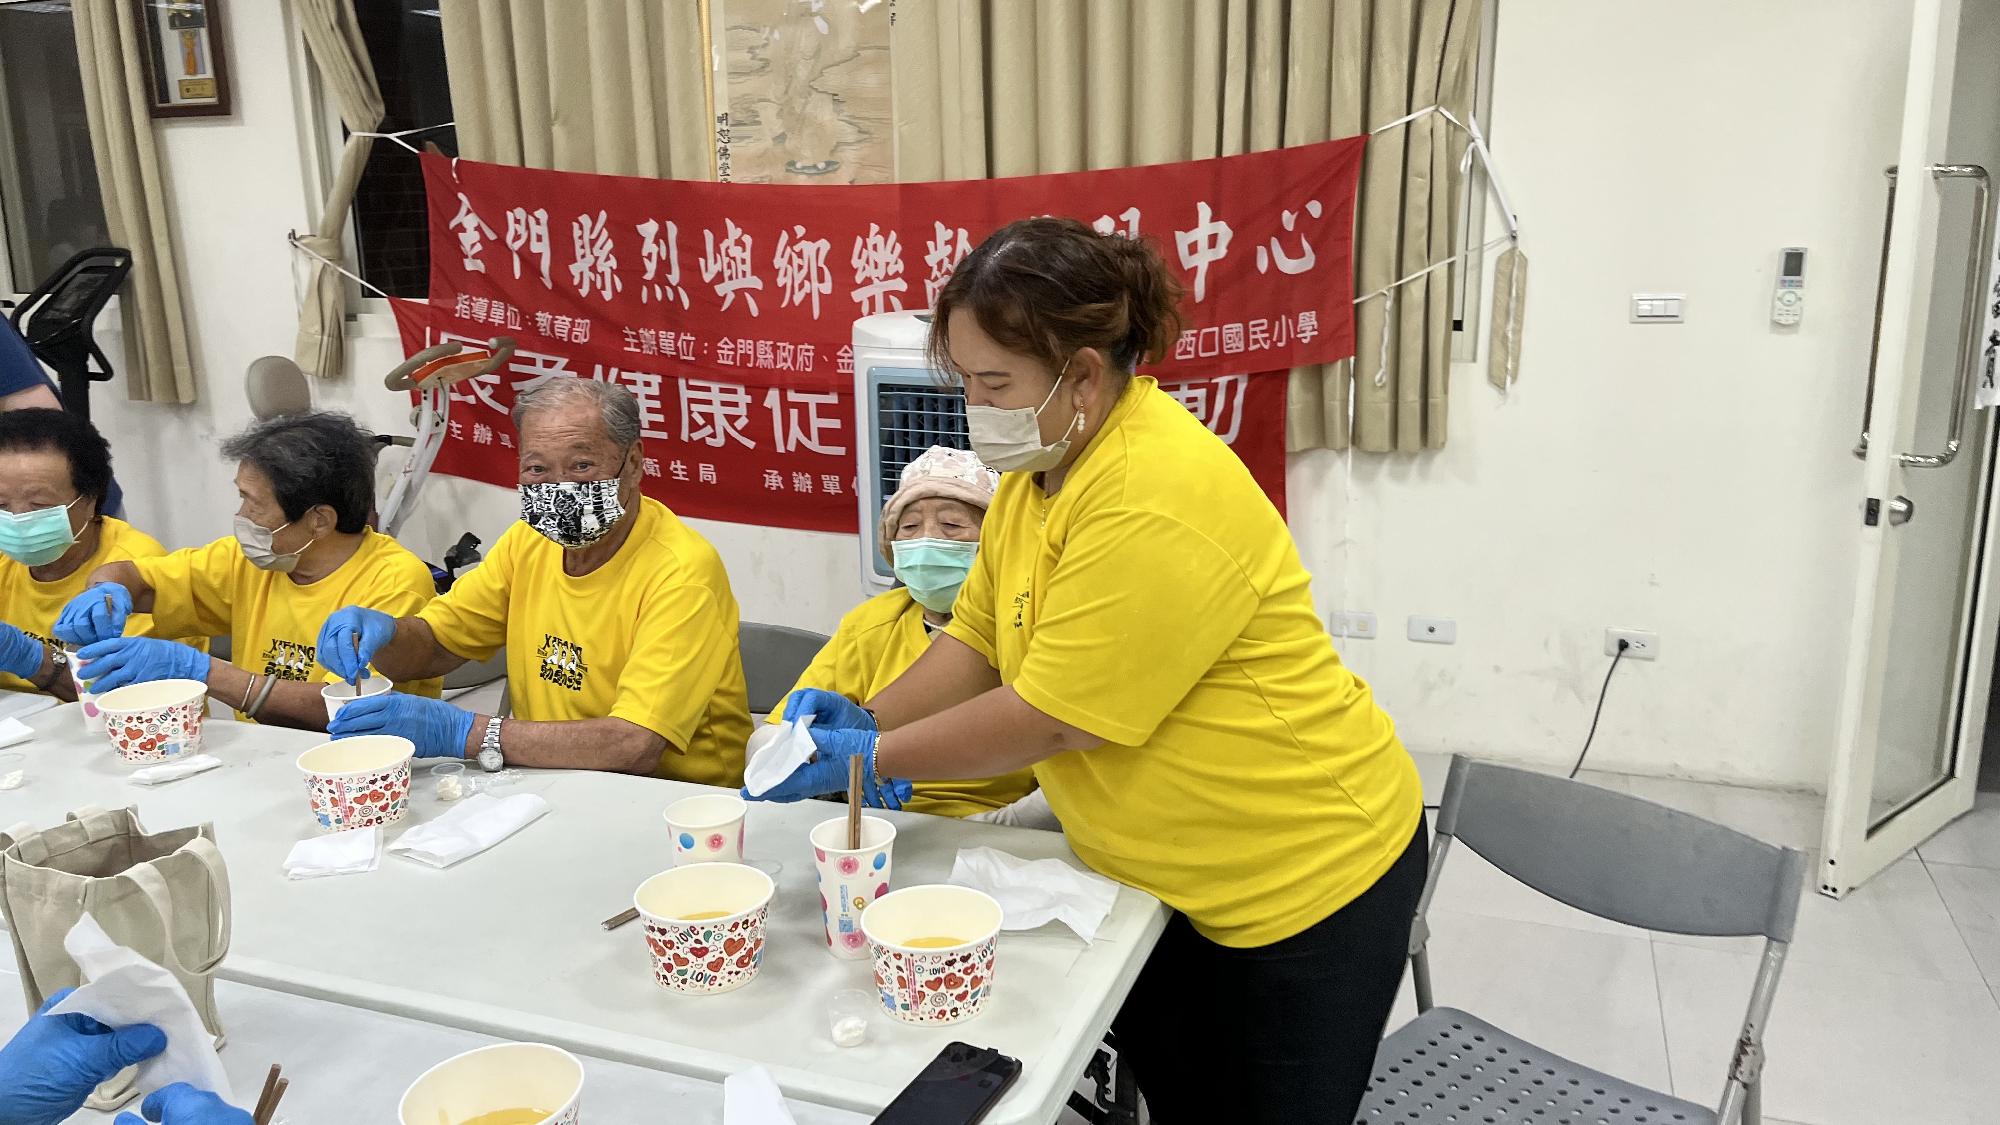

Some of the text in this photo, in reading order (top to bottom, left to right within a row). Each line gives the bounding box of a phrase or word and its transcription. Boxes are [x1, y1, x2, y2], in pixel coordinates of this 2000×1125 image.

[1175, 310, 1319, 361] 西口國民小學
